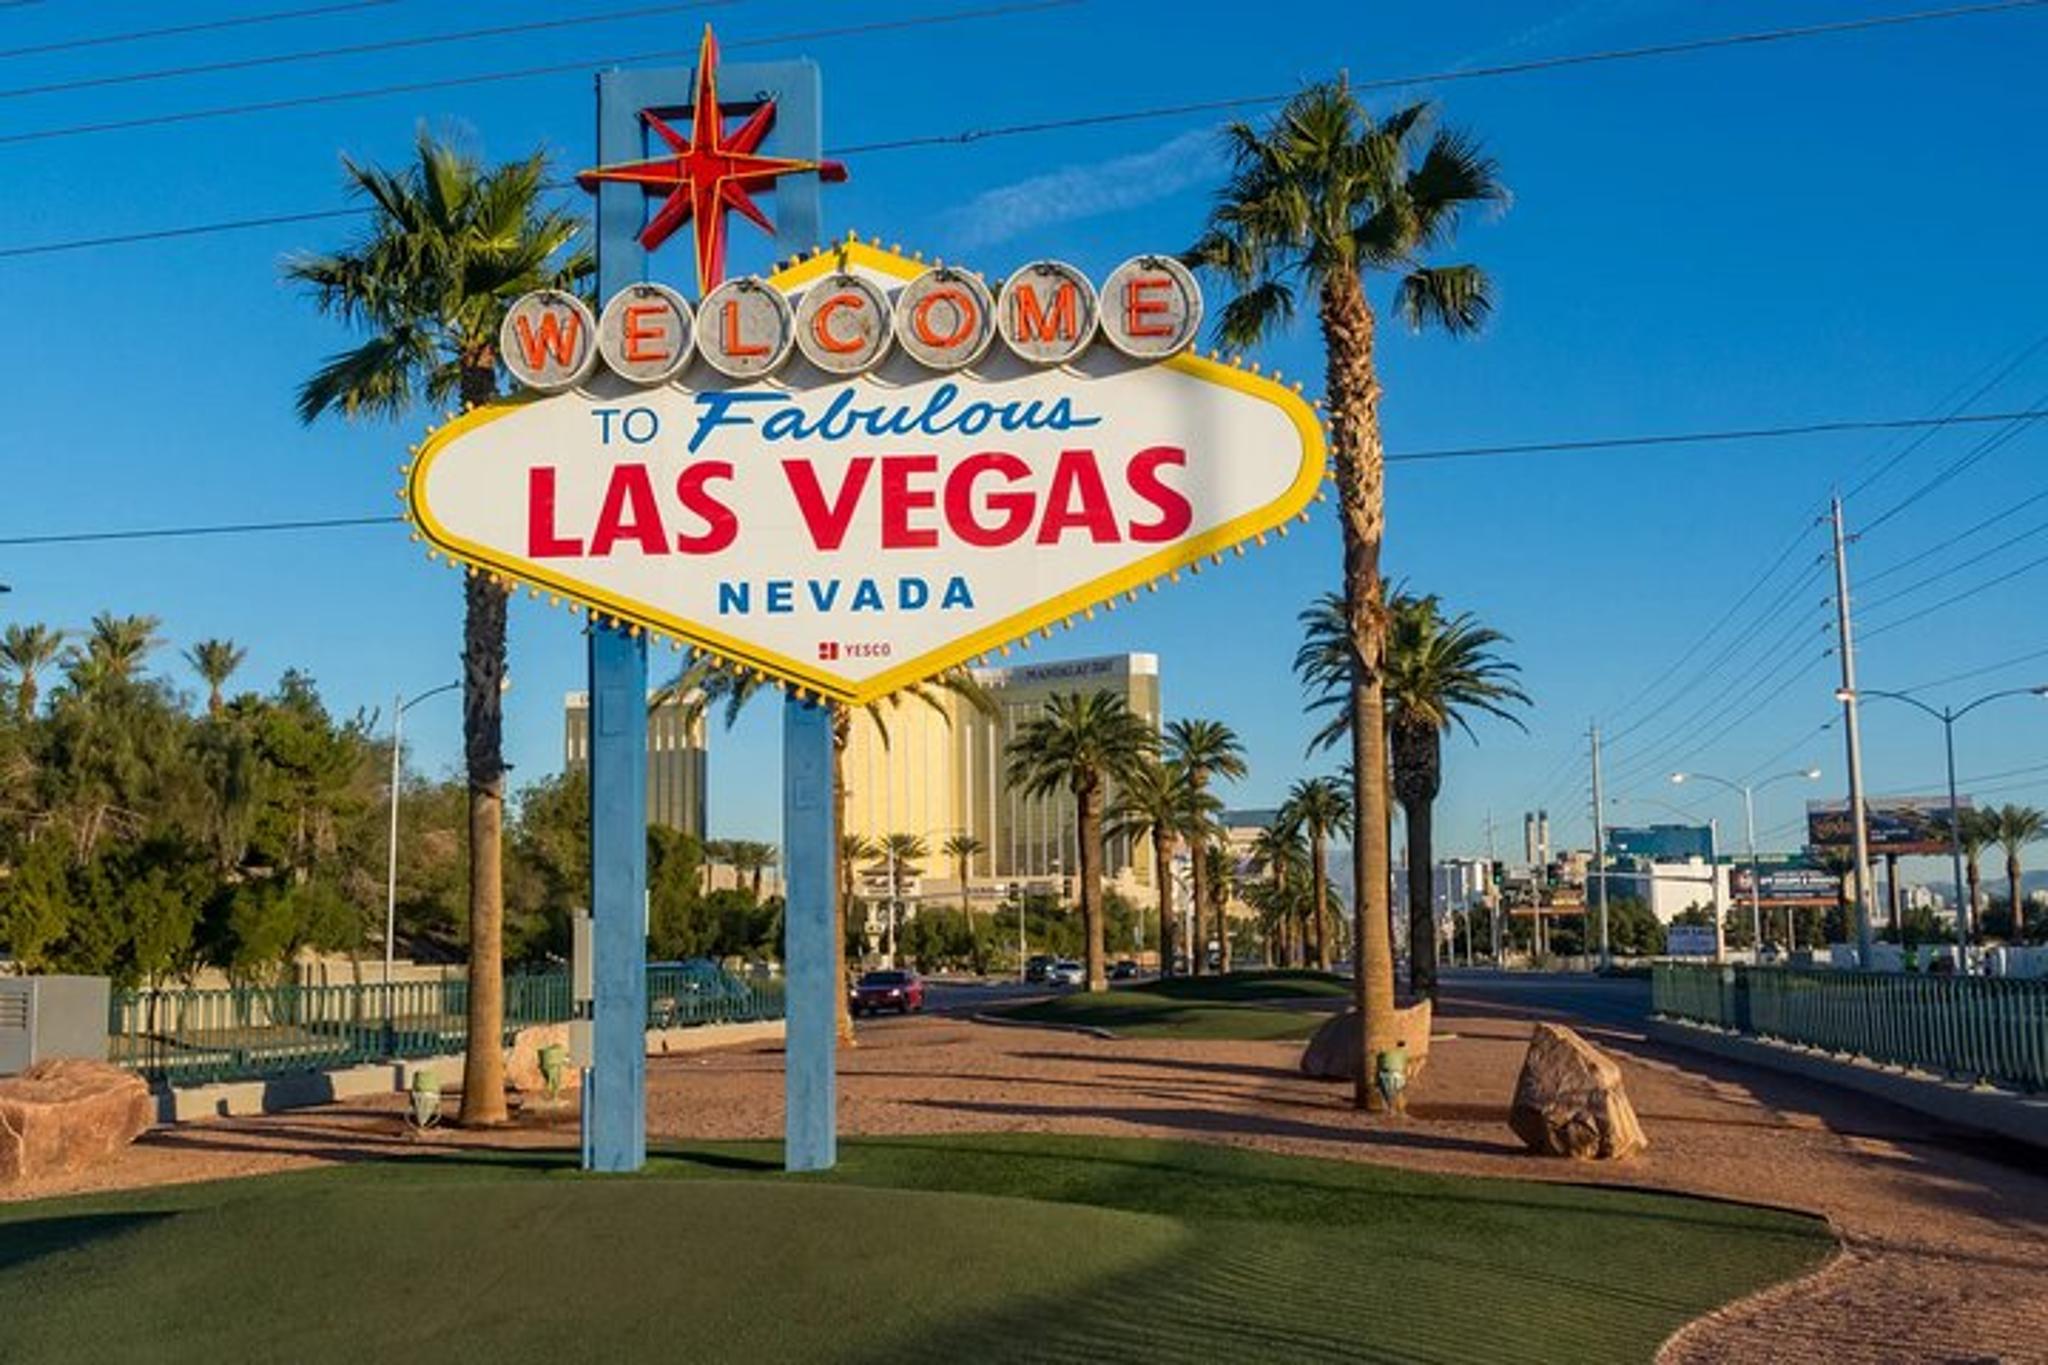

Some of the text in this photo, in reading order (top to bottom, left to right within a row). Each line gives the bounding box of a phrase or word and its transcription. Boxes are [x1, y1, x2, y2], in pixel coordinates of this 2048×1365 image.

[515, 279, 1173, 371] WELCOME
[592, 383, 1100, 454] TO Fabulous
[528, 446, 1192, 558] LAS VEGAS
[719, 577, 974, 614] NEVADA
[844, 642, 891, 657] YESCO
